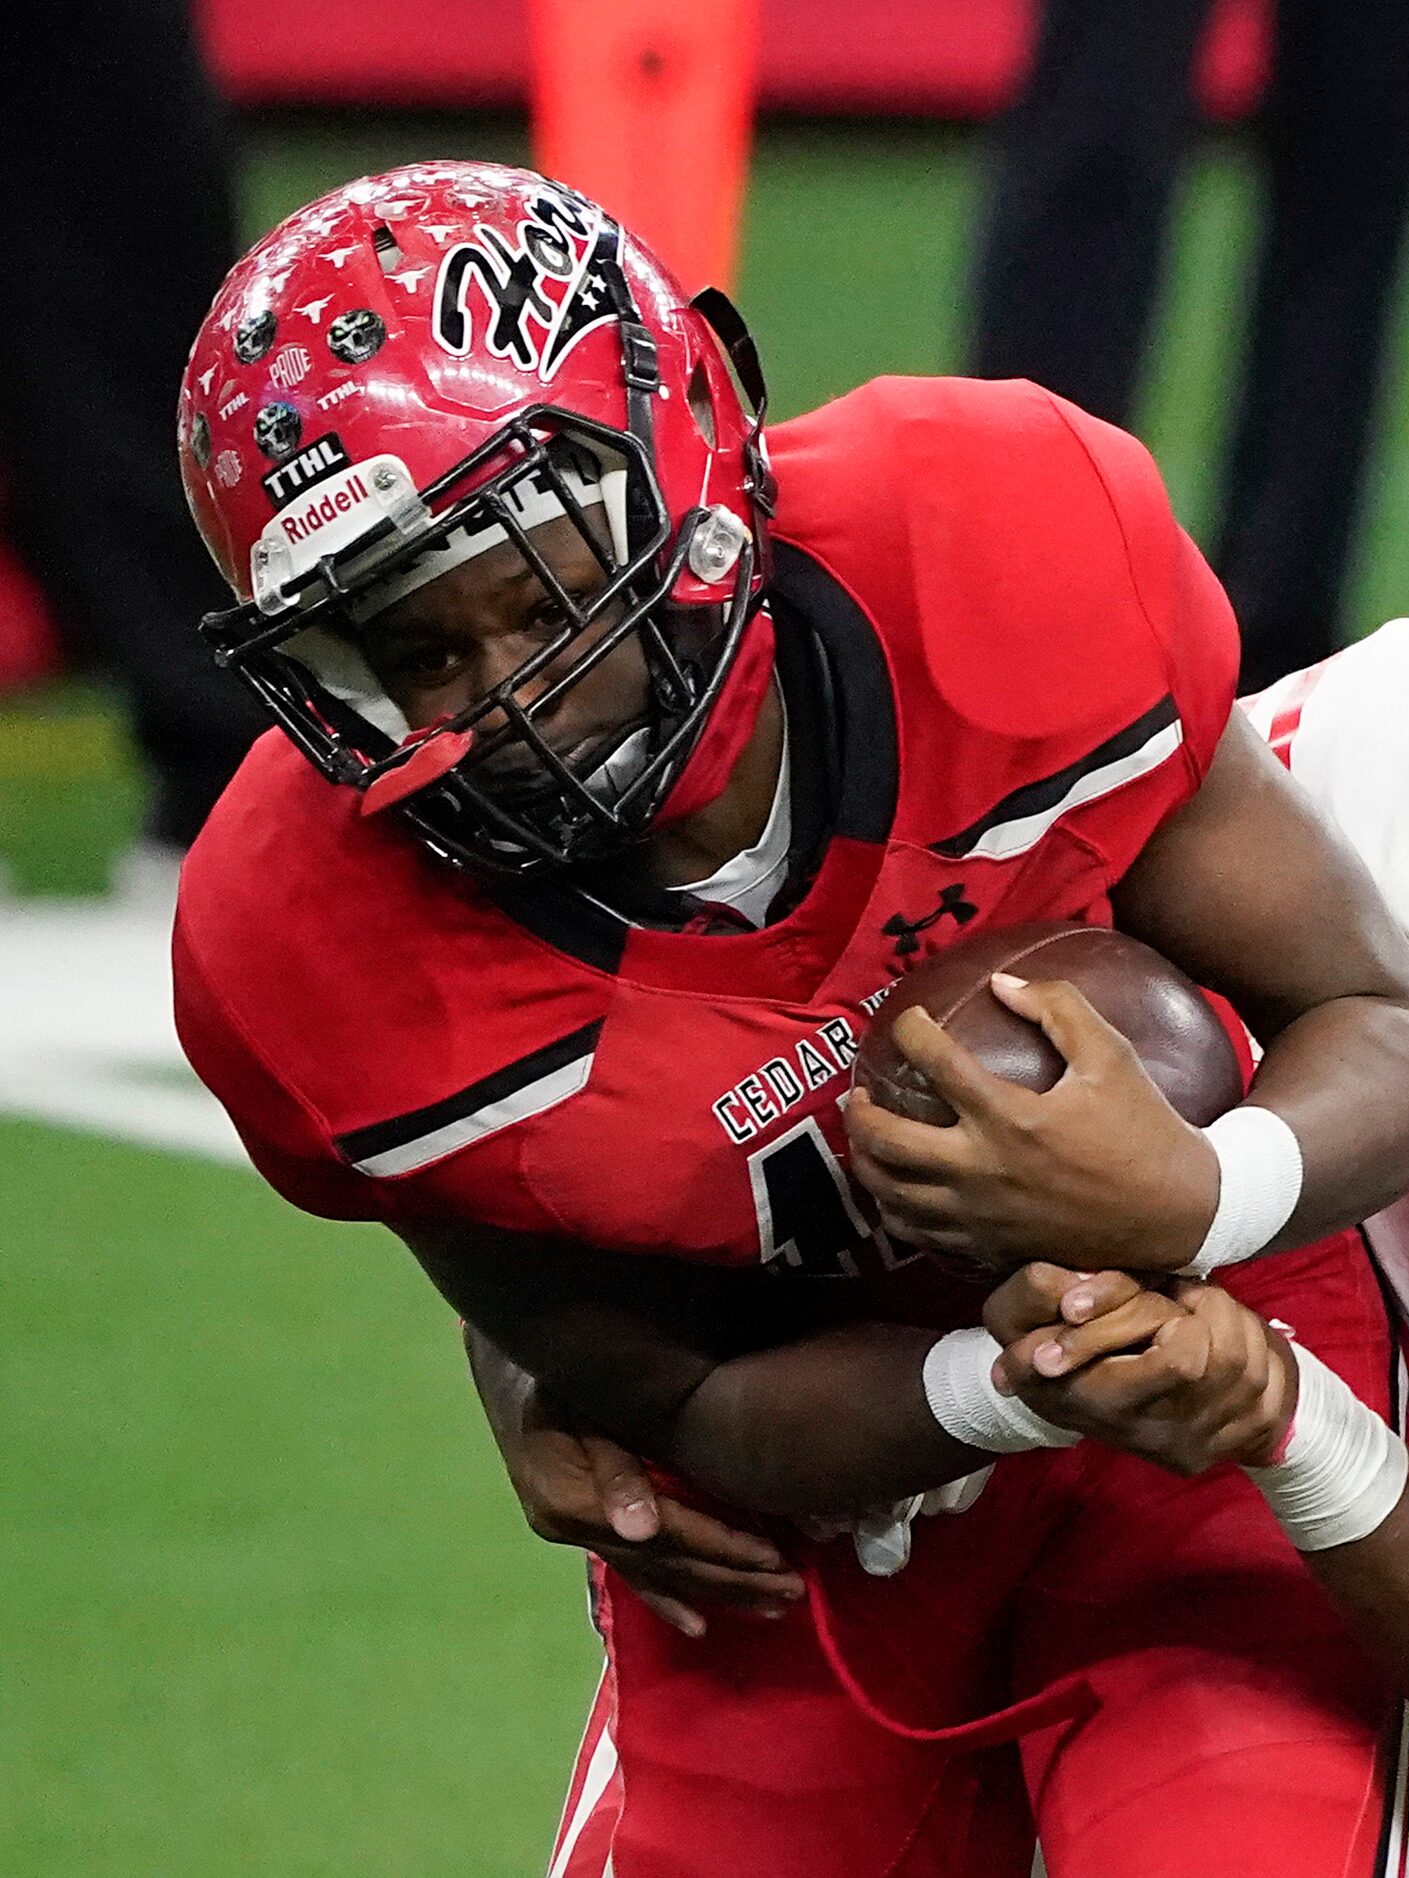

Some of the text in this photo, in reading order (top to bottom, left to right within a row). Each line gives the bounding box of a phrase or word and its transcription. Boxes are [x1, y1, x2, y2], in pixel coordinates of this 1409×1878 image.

[269, 346, 313, 390] PRIDE
[219, 391, 251, 421] TTHL
[317, 380, 360, 412] TTHL
[264, 440, 344, 499] TTHL
[280, 474, 369, 545] Riddell
[711, 1016, 860, 1145] CEDAR
